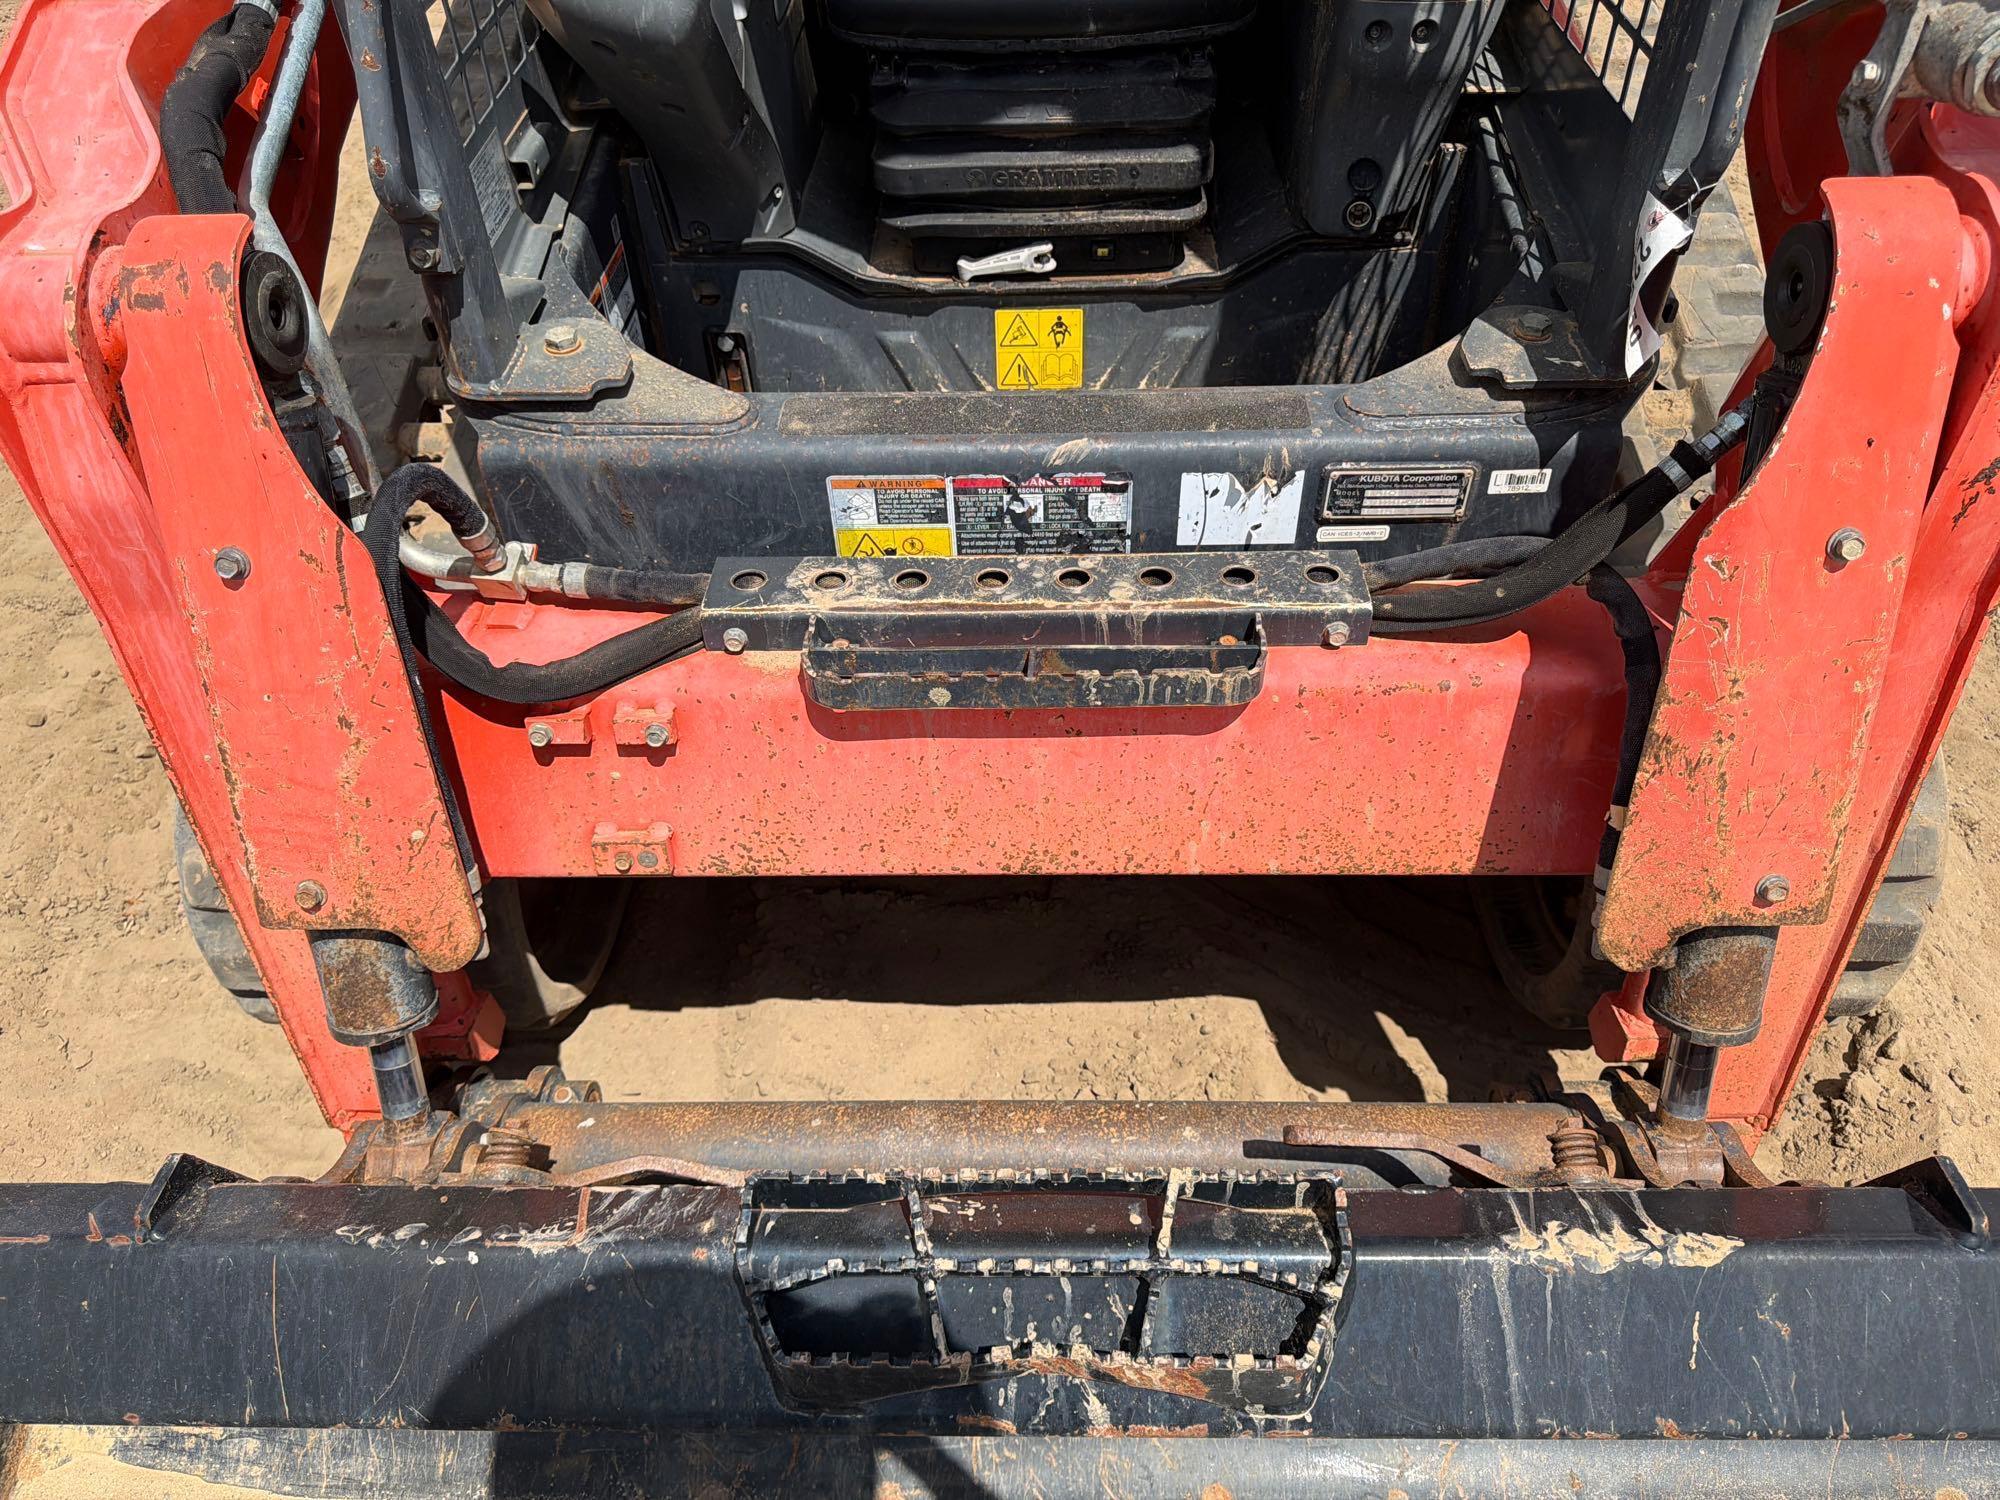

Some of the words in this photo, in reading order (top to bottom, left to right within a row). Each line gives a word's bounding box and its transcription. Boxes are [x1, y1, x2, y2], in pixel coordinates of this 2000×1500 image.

[991, 169, 1118, 187] GRAMMER
[1360, 475, 1400, 483] KUBOTA
[1402, 474, 1458, 483] Corporation
[869, 480, 922, 488] WARNING
